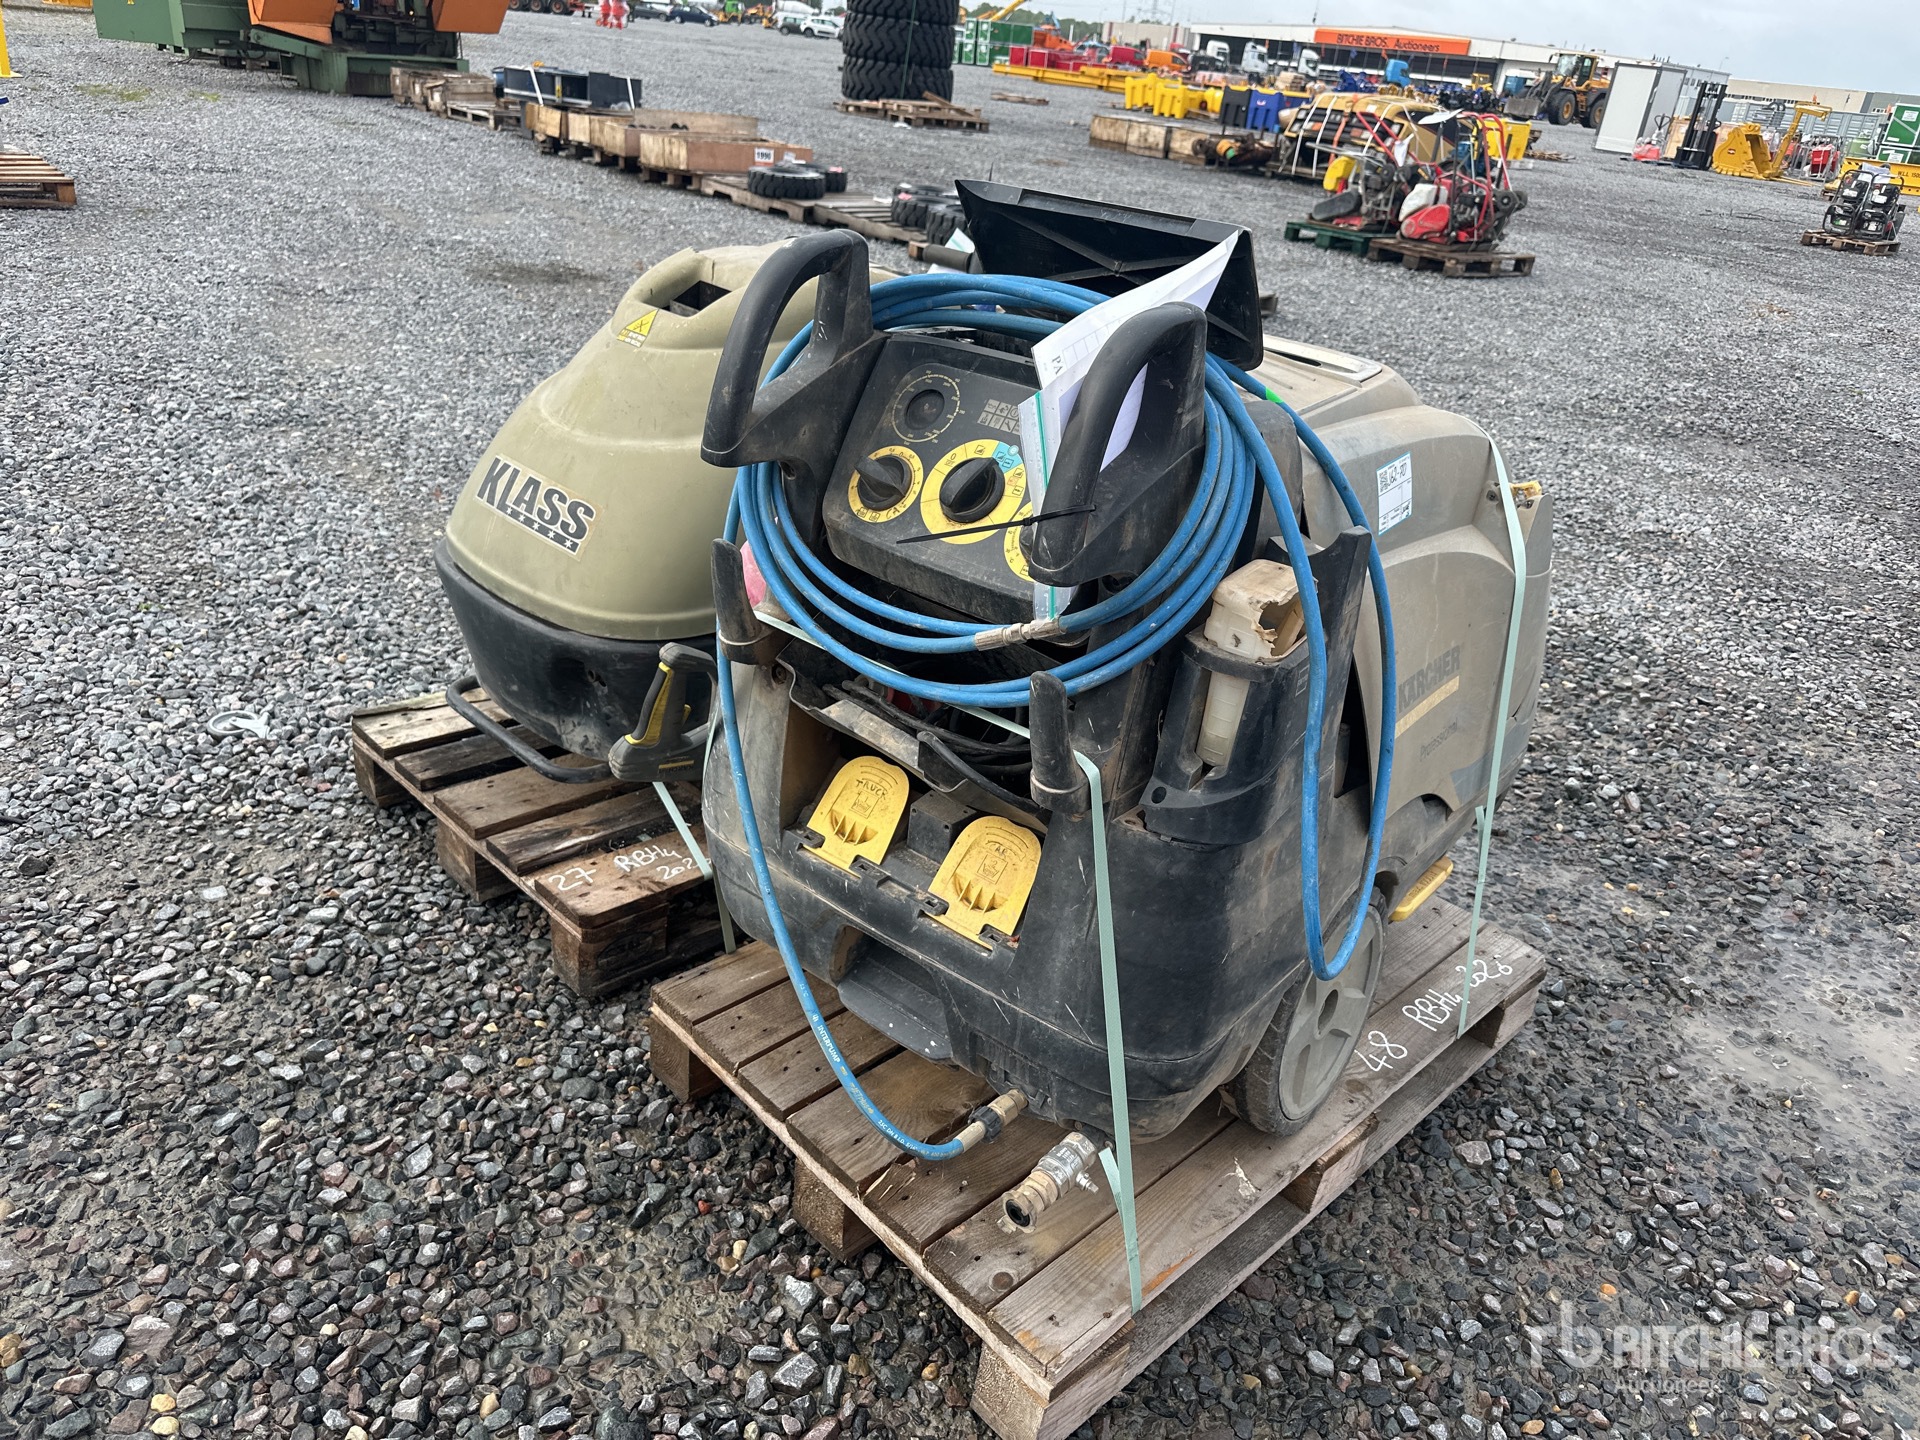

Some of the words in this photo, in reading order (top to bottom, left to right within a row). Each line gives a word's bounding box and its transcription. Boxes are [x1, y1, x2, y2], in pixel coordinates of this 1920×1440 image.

[1394, 38, 1440, 52] Auctioneers
[950, 453, 957, 461] 0
[477, 457, 596, 541] KLASS
[550, 868, 596, 891] 27
[656, 857, 711, 881] 202
[817, 1025, 840, 1062] INTERPUMP
[1354, 1030, 1408, 1071] 48
